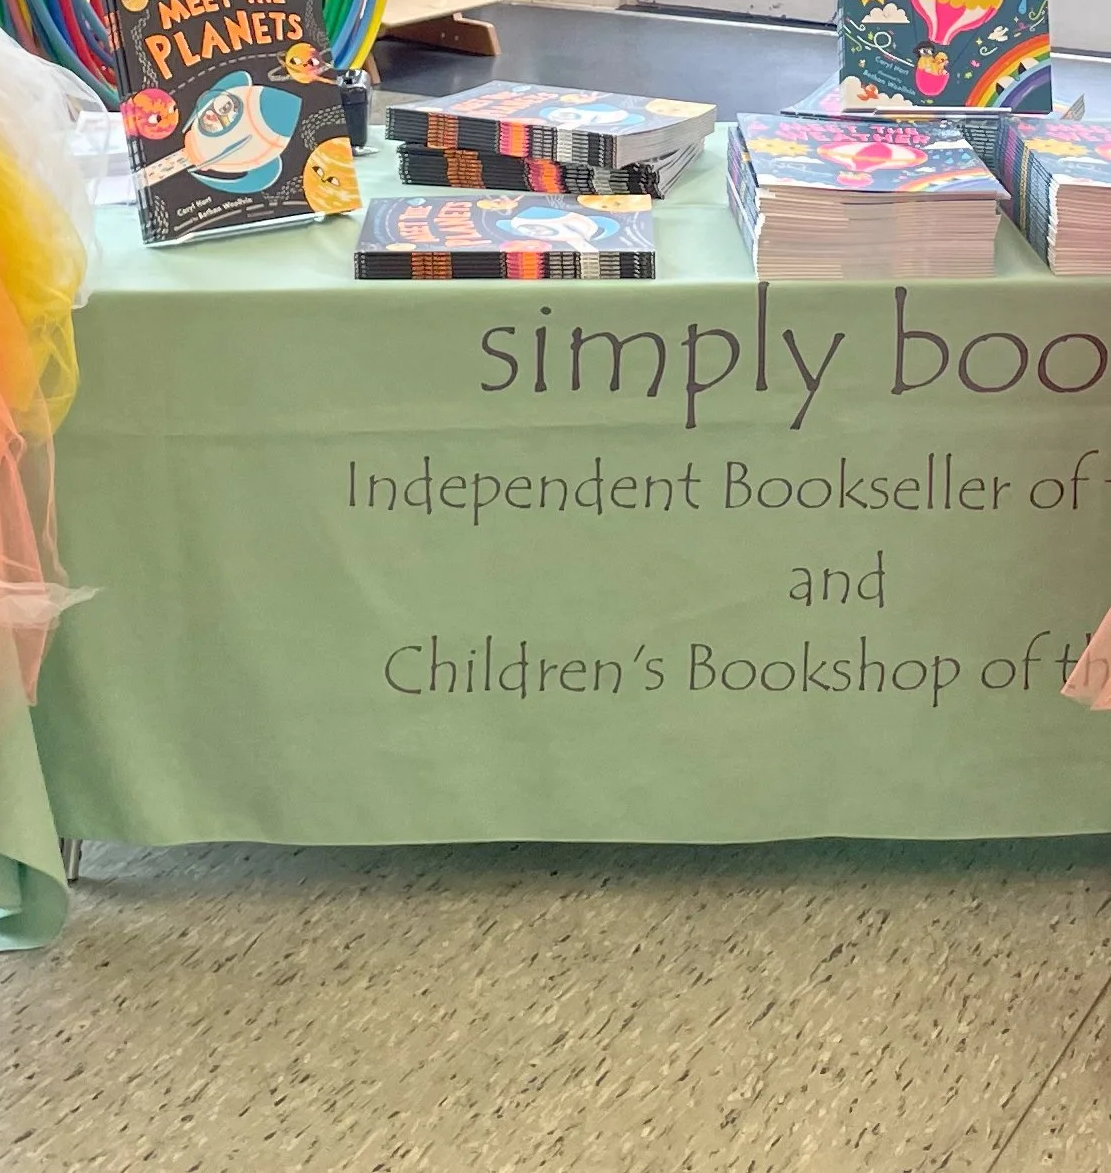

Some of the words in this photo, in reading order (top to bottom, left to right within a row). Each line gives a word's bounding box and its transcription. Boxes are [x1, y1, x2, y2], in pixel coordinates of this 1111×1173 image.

[144, 9, 303, 80] PLANETS
[480, 281, 845, 431] simply
[890, 285, 1109, 395] boo
[349, 455, 702, 526] Independent
[724, 452, 1011, 511] Bookseller
[1029, 450, 1100, 511] of
[789, 550, 885, 608] and
[384, 635, 665, 699] Children's
[689, 635, 960, 709] Bookshop
[980, 630, 1051, 690] of
